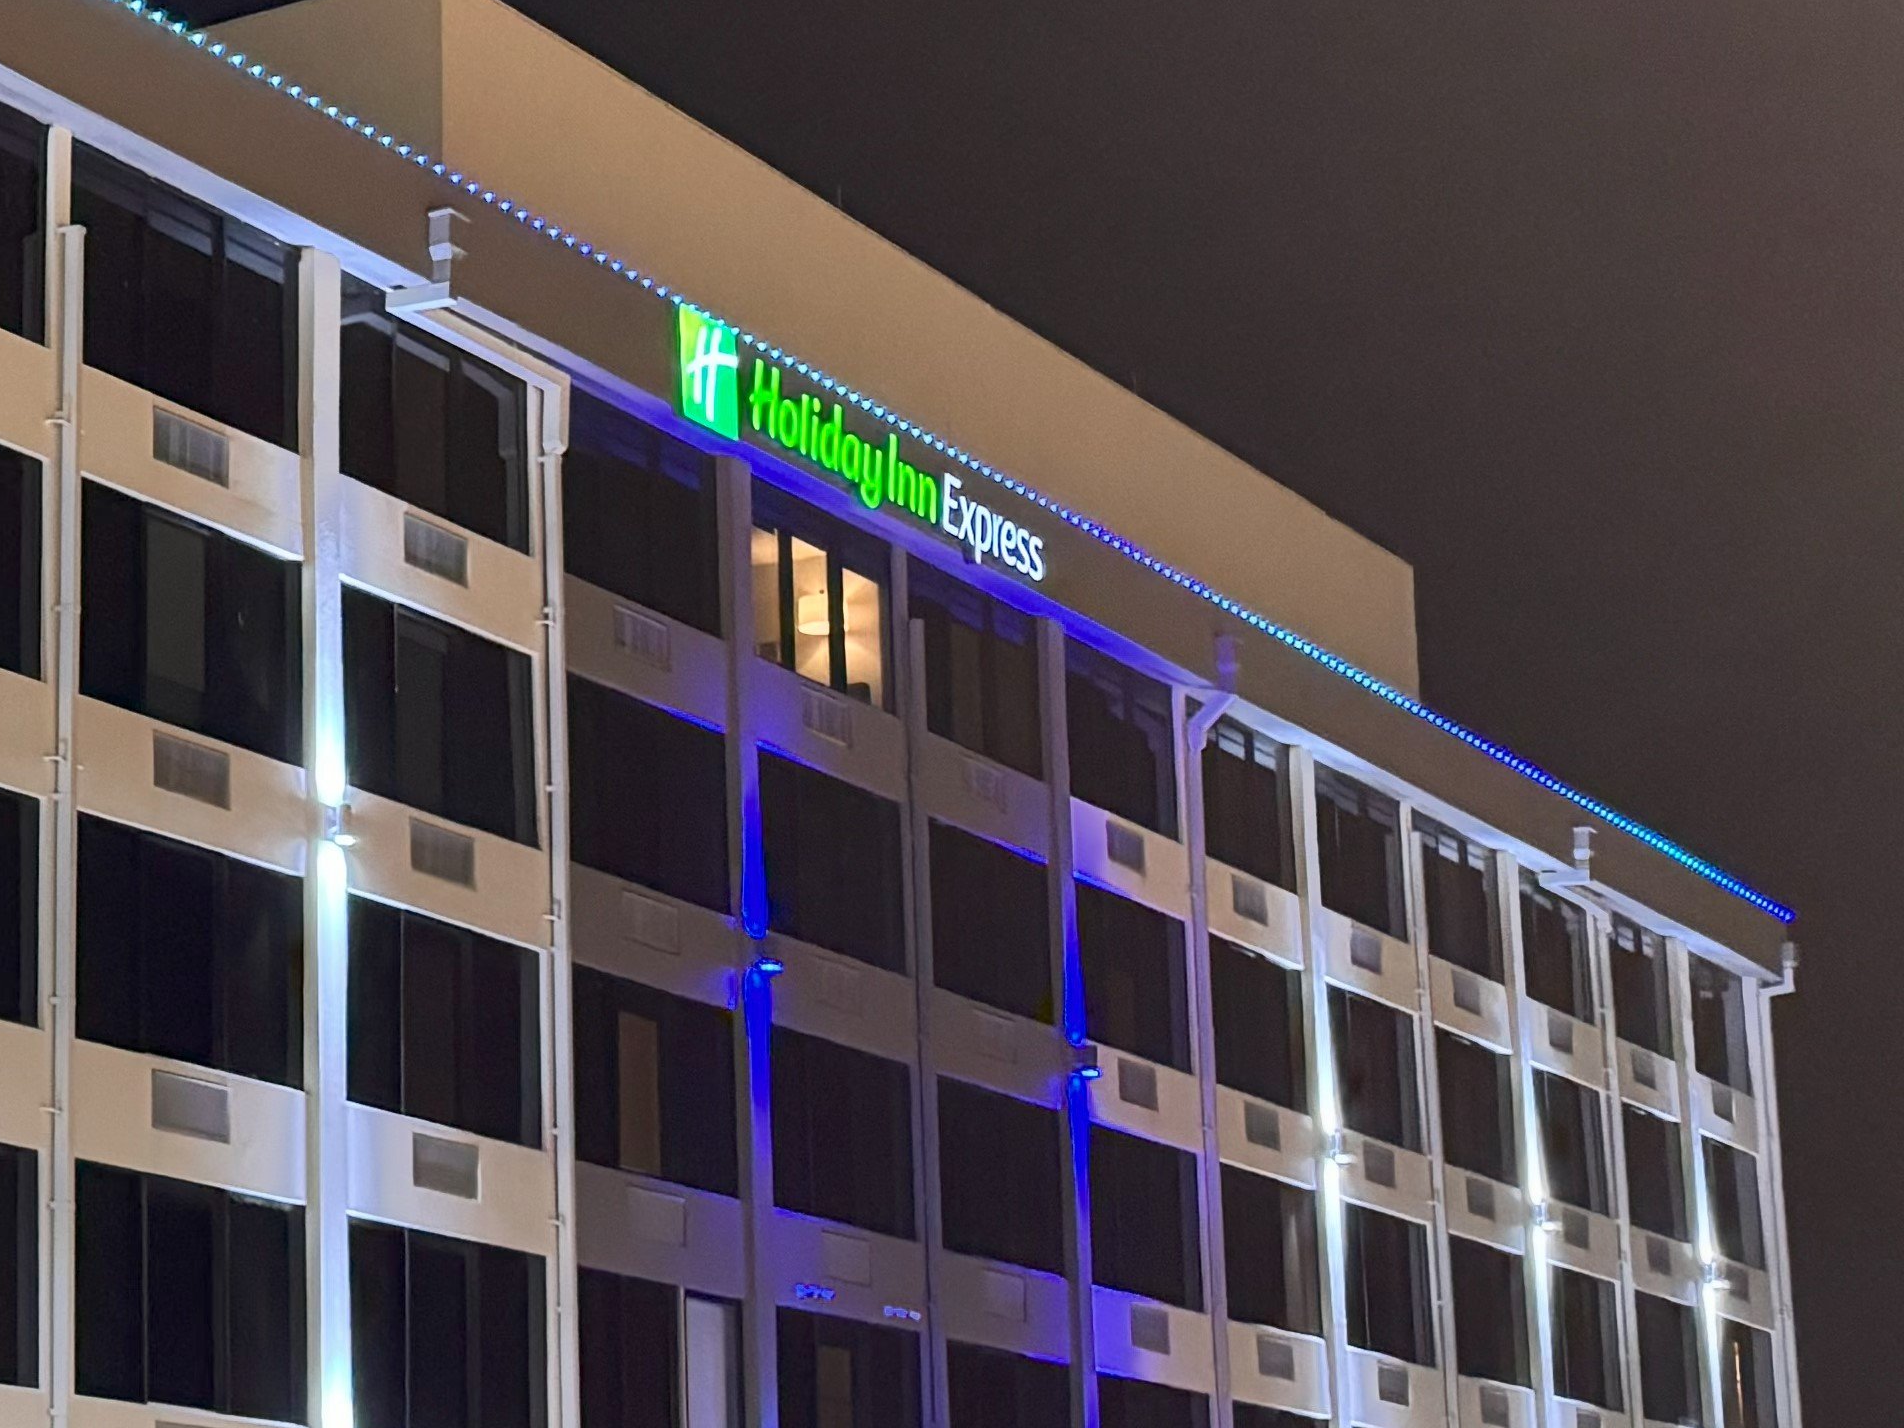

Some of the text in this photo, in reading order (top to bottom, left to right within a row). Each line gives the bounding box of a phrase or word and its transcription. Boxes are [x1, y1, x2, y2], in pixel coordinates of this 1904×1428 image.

[748, 358, 1046, 583] Holiday Inn Express
